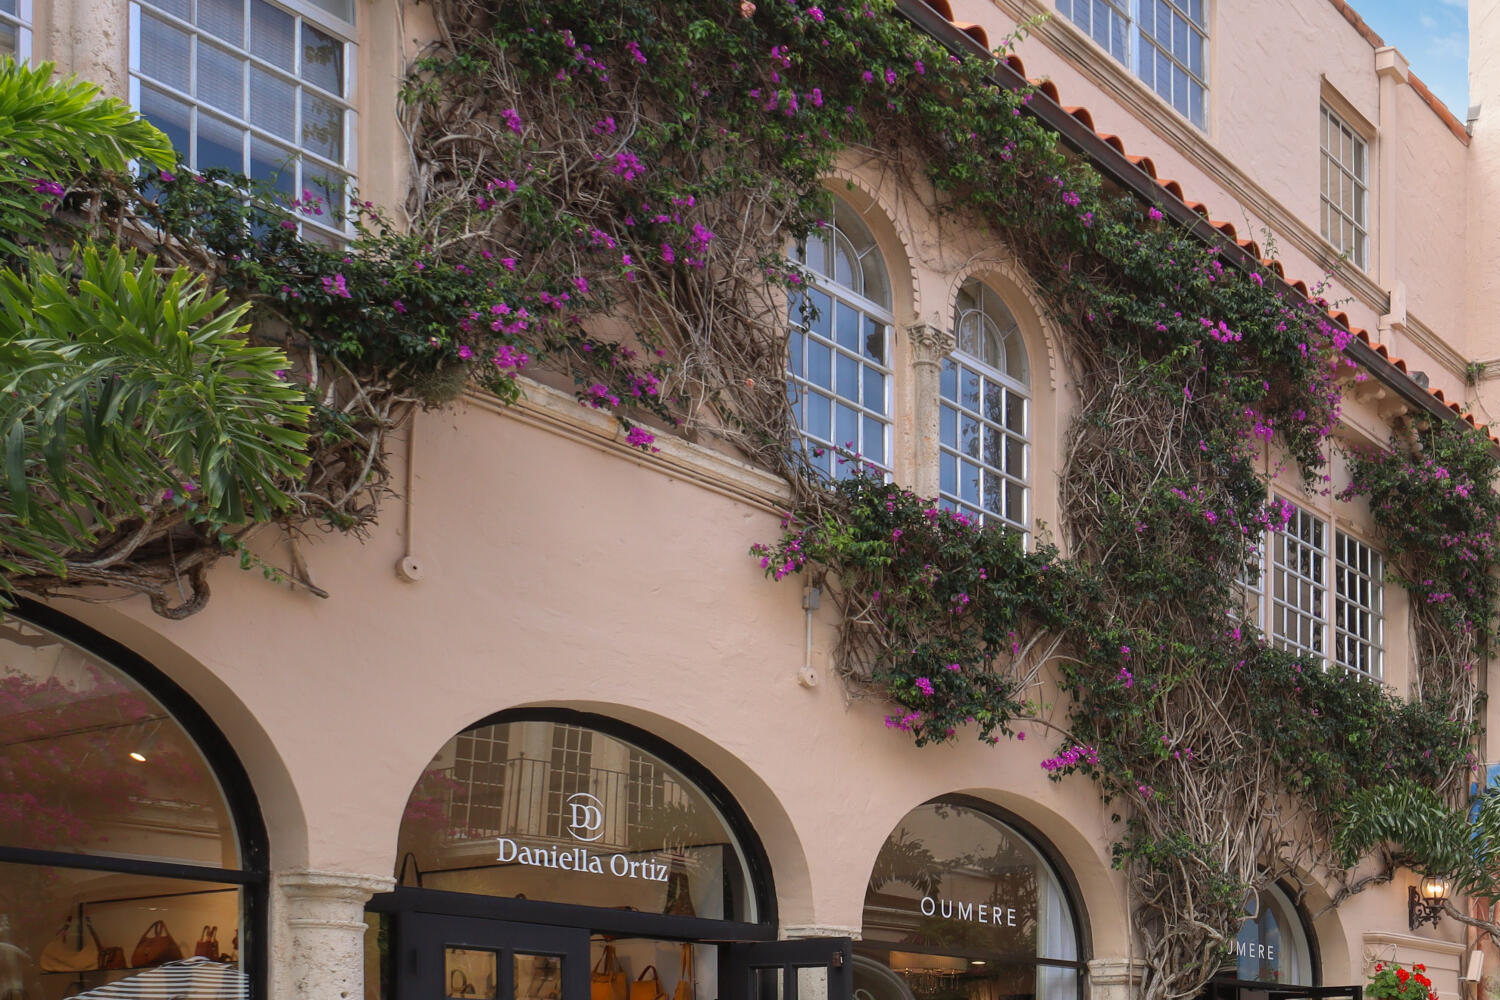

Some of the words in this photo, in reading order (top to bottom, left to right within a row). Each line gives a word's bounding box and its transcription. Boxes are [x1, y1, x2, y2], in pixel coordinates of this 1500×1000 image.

[496, 838, 604, 875] Daniella
[610, 854, 669, 882] Ortiz
[920, 896, 1017, 927] OUMERE
[1227, 940, 1275, 961] UMERE
